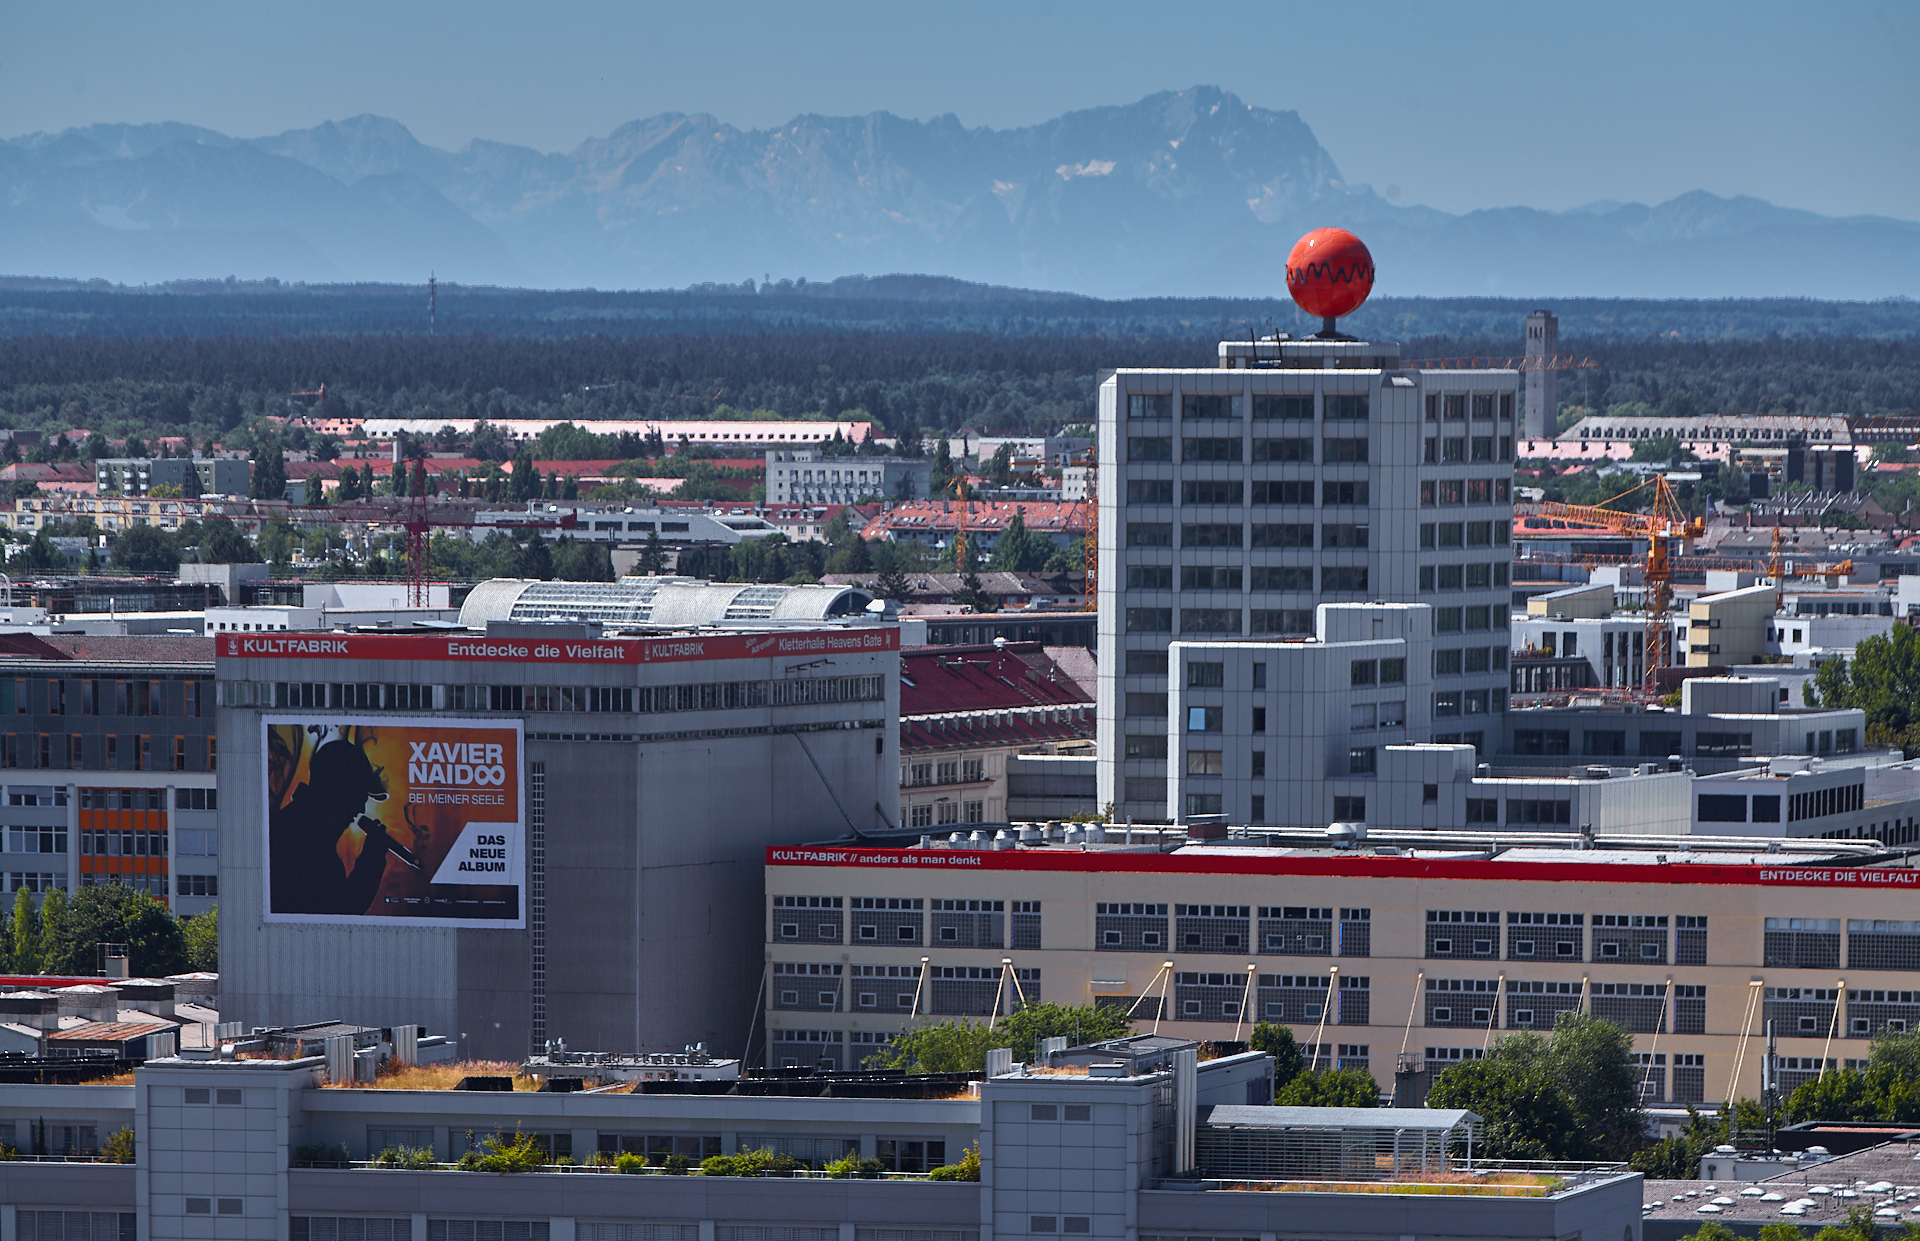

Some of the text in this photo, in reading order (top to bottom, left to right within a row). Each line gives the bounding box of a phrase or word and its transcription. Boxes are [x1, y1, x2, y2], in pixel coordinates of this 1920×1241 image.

[243, 639, 349, 654] KULTFABRIK
[652, 642, 704, 658] KULTFABRIK
[745, 637, 758, 649] 30m
[750, 636, 776, 655] Adrenalin
[779, 637, 825, 651] Kletterhalle
[827, 636, 862, 649] Heavens
[863, 634, 882, 648] Gate
[448, 642, 625, 659] Entdecke die Vielfalt
[409, 741, 504, 764] XAVIER
[409, 793, 505, 805] BEI MEINER SEELE
[477, 835, 506, 845] DAS
[469, 848, 506, 859] NEUE
[772, 850, 847, 862] KULTFABRIK
[859, 854, 899, 864] anders
[901, 855, 918, 864] als
[921, 856, 946, 865] man
[948, 855, 981, 865] denkt
[458, 861, 506, 872] ALBUM
[1759, 870, 1919, 883] ENTDECKE DIE VIELFALT
